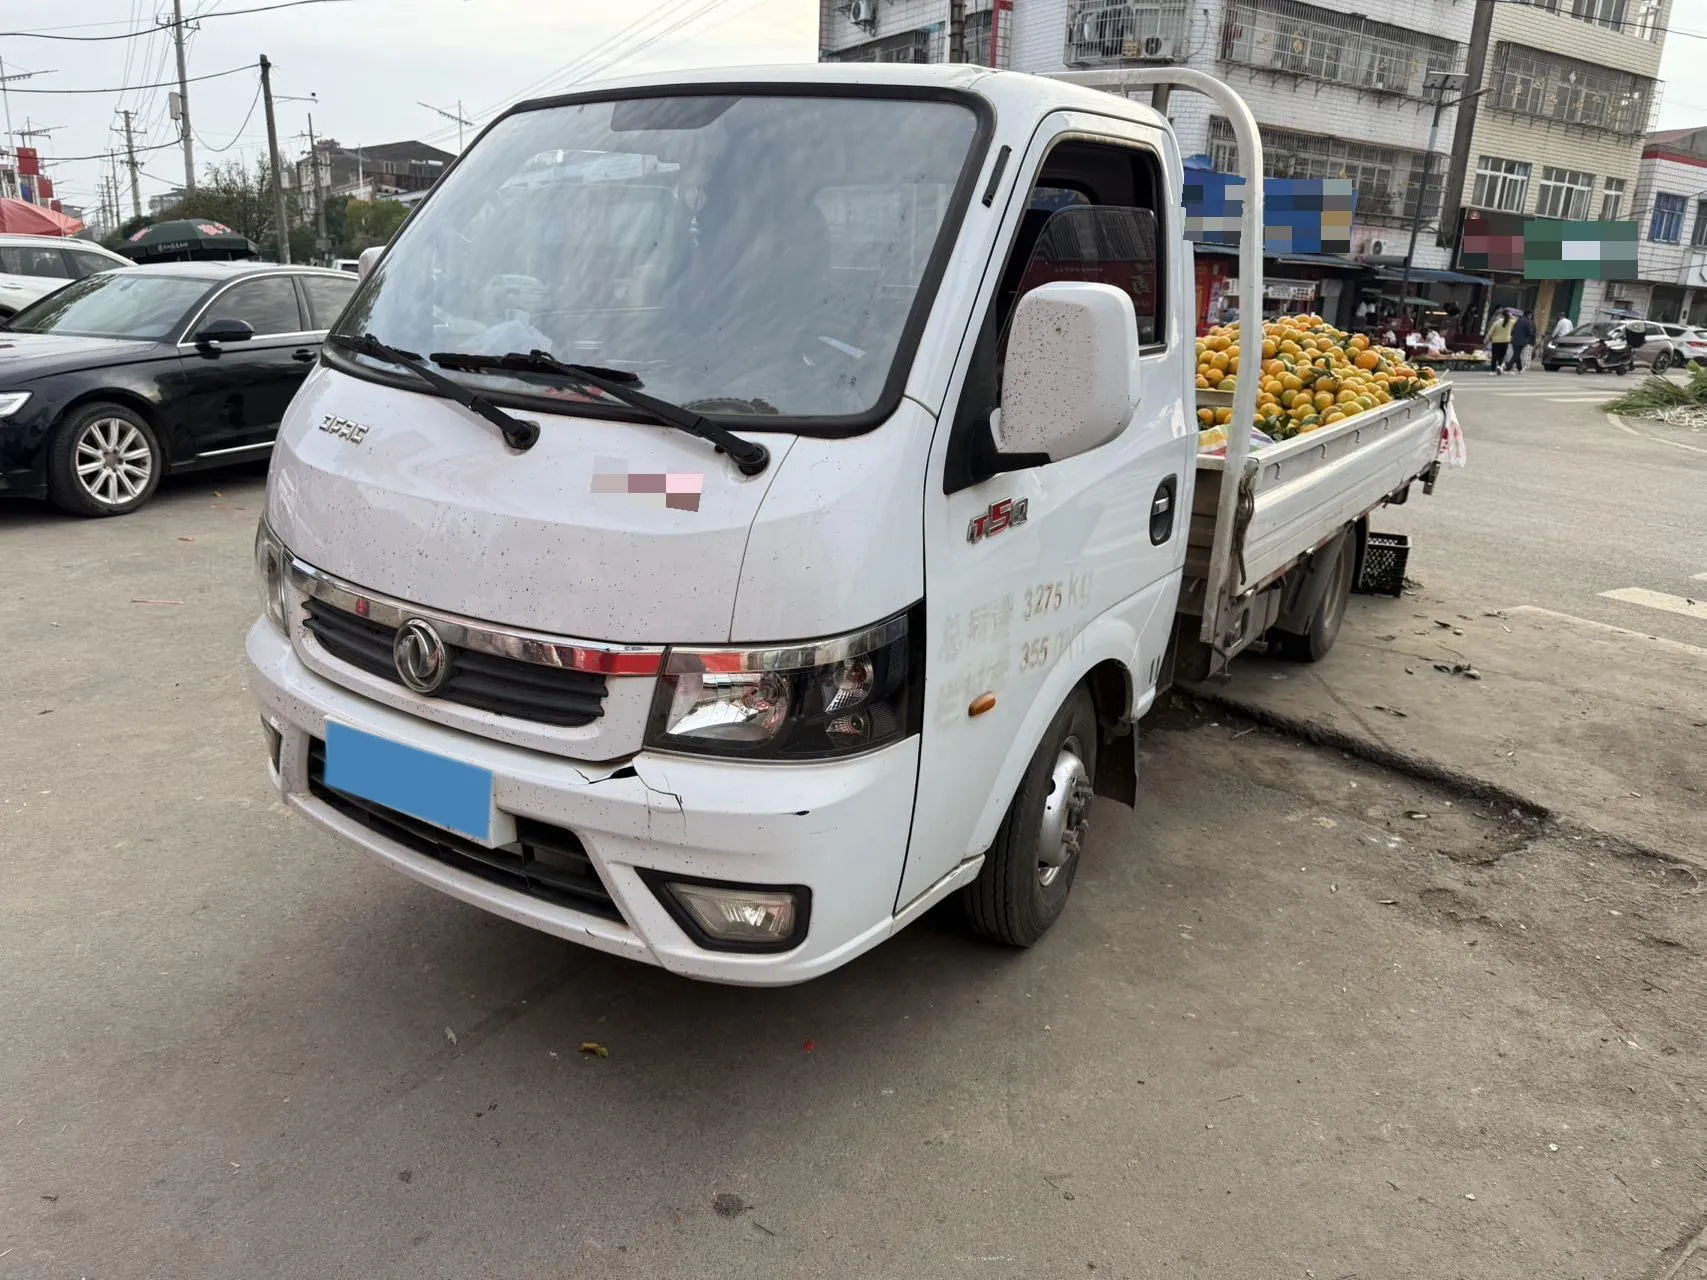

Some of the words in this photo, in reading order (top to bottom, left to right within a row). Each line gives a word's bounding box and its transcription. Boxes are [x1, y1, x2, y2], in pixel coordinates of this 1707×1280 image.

[318, 413, 369, 444] DFAC
[1023, 581, 1063, 621] 3275
[1019, 634, 1049, 672] 355
